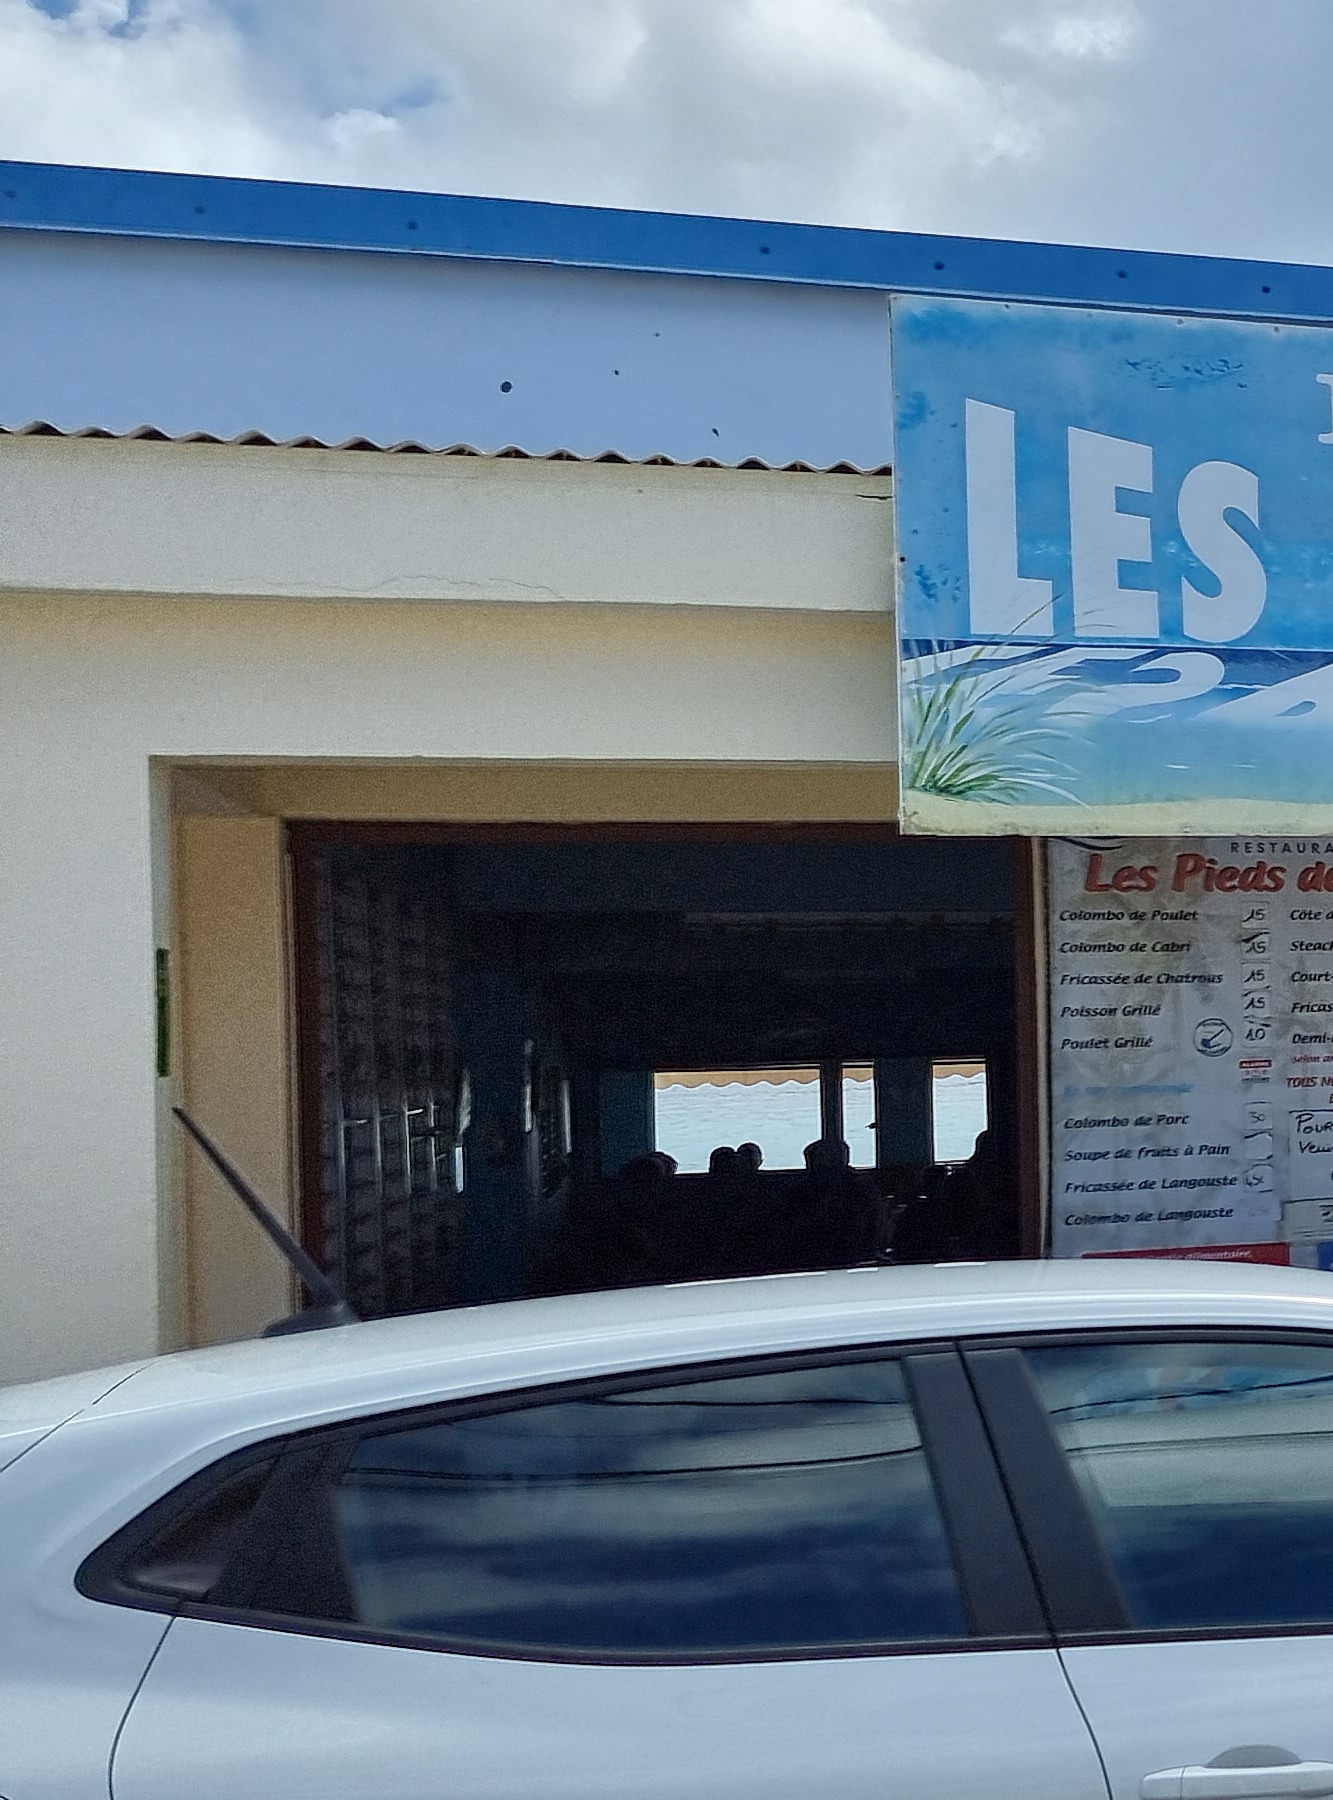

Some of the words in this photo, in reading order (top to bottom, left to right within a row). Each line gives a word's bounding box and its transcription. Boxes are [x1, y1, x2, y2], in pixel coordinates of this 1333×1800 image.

[965, 397, 1267, 644] LES
[1085, 853, 1158, 893] Les
[1171, 853, 1288, 893] Pieds
[1059, 910, 1126, 922] Colombo
[1129, 910, 1147, 921] de
[1152, 909, 1199, 922] Poulet
[1290, 908, 1322, 921] Côte
[1059, 942, 1126, 954] Colombo
[1129, 941, 1148, 953] de
[1151, 940, 1191, 954] Cabri
[1060, 973, 1129, 985] Fricassée
[1133, 973, 1152, 985] de
[1244, 968, 1266, 983] 15
[1244, 997, 1266, 1010] 15
[1061, 1005, 1118, 1018] Poisson
[1122, 1004, 1161, 1017] Grillé
[1061, 1038, 1110, 1050] Poulet
[1114, 1036, 1154, 1049] Grillé
[1287, 1075, 1318, 1088] TOUS
[1064, 1116, 1129, 1130] Colombo
[1133, 1115, 1153, 1127] de
[1156, 1113, 1191, 1126] Porc
[1064, 1149, 1110, 1162] Soupe
[1113, 1148, 1132, 1160] de
[1183, 1144, 1195, 1157] à
[1198, 1143, 1231, 1156] Pain
[1064, 1181, 1134, 1194] Fricassée
[1138, 1179, 1155, 1191] de
[1161, 1175, 1238, 1191] Langouste
[1065, 1213, 1130, 1227] Colombo
[1134, 1211, 1153, 1223] de
[1157, 1207, 1234, 1223] Langouste
